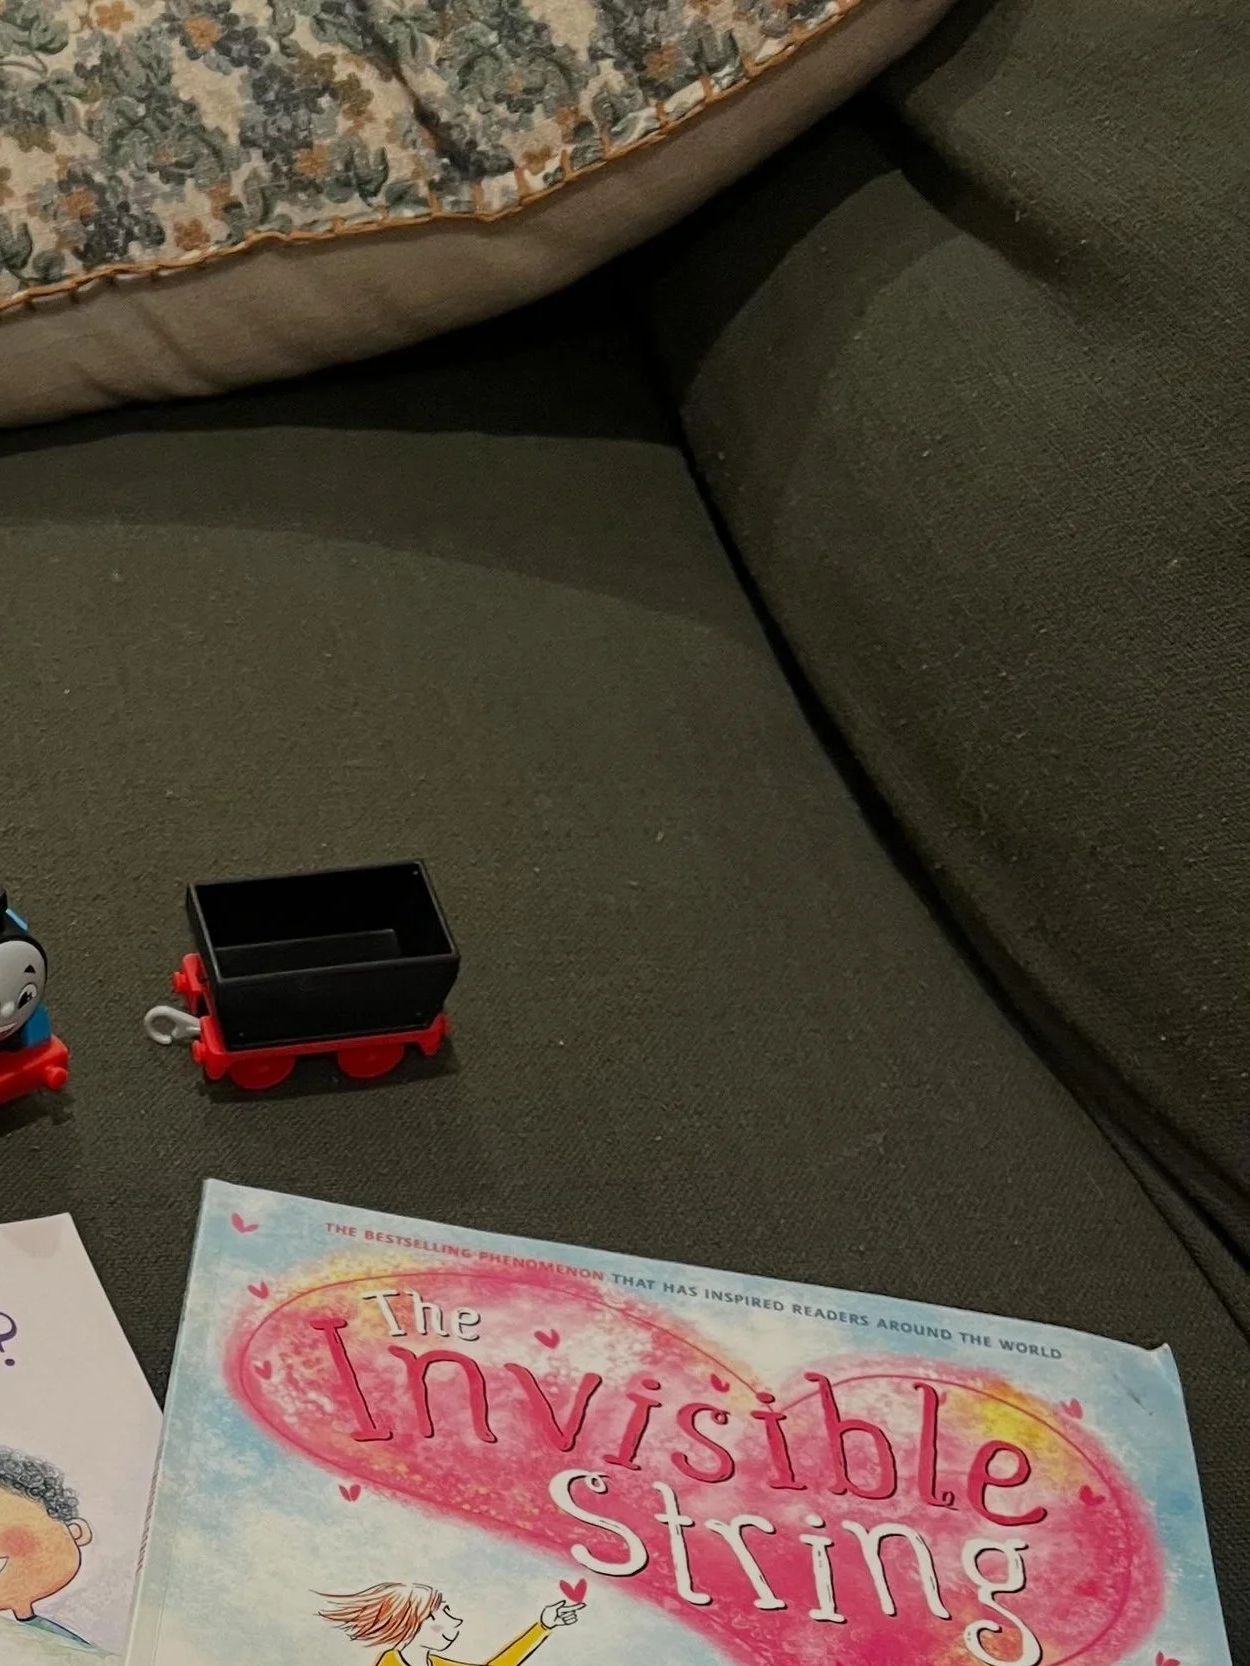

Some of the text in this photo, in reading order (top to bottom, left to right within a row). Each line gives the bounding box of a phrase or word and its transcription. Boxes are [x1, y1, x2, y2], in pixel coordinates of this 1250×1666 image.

[325, 1222, 1063, 1360] THE BESTSELLING PHENOMENON THAT HAS INSPIRED READERS AROUND THE WORLD
[362, 1288, 482, 1342] The
[312, 1316, 1048, 1528] Invisible
